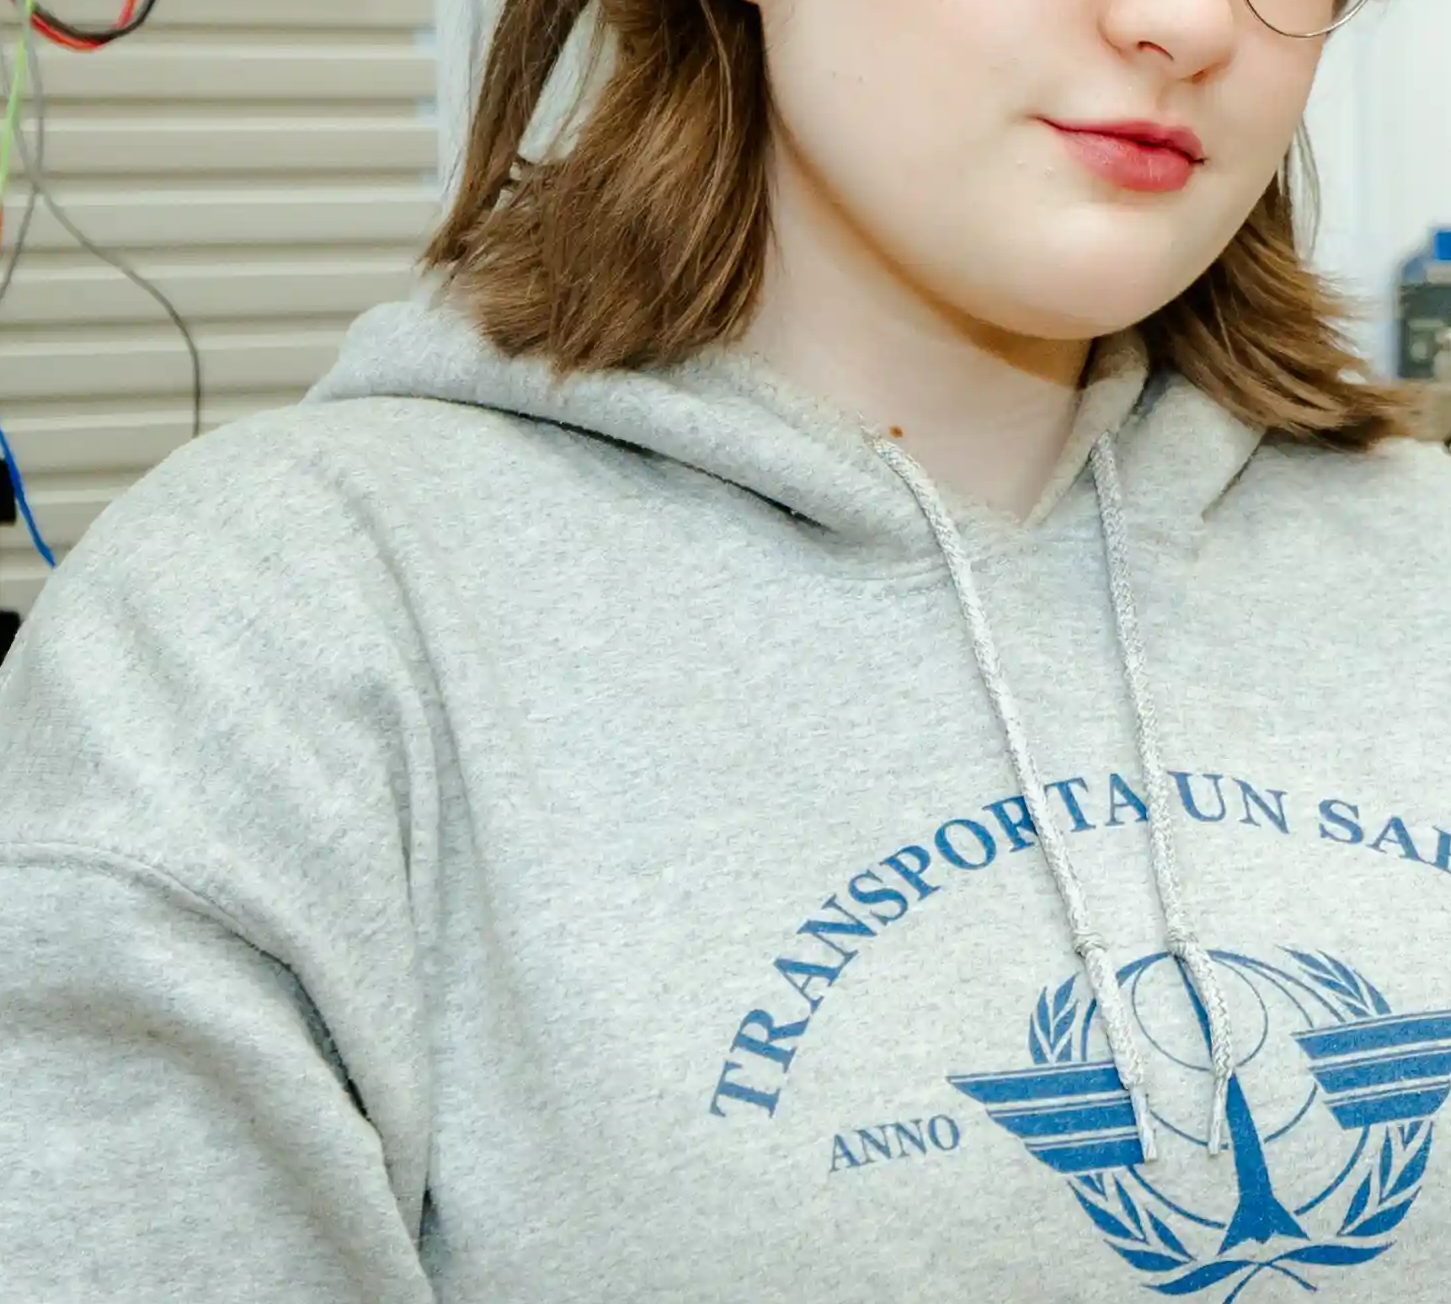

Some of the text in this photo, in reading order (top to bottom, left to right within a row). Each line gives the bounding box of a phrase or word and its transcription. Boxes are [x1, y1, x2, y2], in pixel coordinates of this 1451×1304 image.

[709, 772, 1149, 1119] TRANSPORTA
[1166, 770, 1289, 835] UN
[828, 1113, 961, 1173] ANNO
